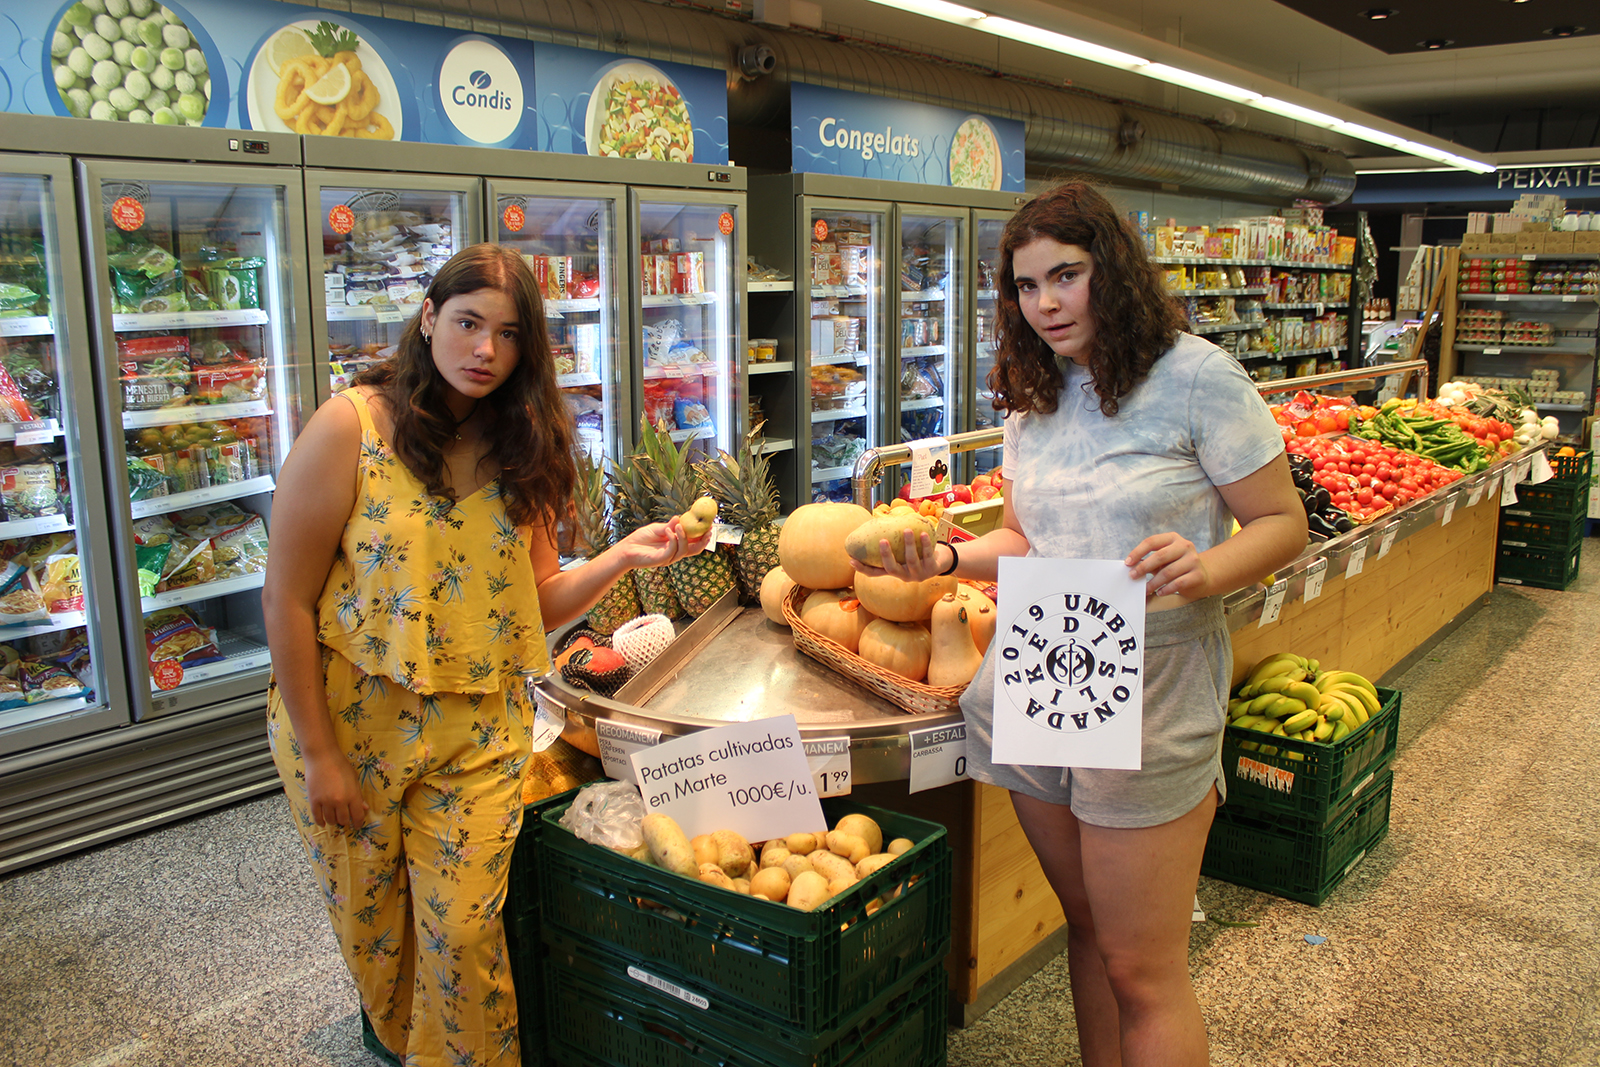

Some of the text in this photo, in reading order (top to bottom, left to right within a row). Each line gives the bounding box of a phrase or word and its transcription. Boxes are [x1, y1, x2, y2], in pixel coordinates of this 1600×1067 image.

[452, 85, 512, 112] Condis
[818, 117, 920, 160] Congelats
[1497, 166, 1600, 190] PEIXATE
[125, 384, 169, 395] MENESTRA
[1002, 594, 1139, 731] UMBRIONADA 2019
[1024, 616, 1117, 706] DISLIKE
[600, 724, 655, 745] RECOMANEM
[923, 727, 967, 745] +ESTAL
[640, 733, 794, 785] Patatas cultivadas
[912, 746, 943, 758] CARBASSA
[954, 756, 967, 777] 0
[649, 773, 728, 808] en Marte
[727, 780, 812, 807] 1000€/u.
